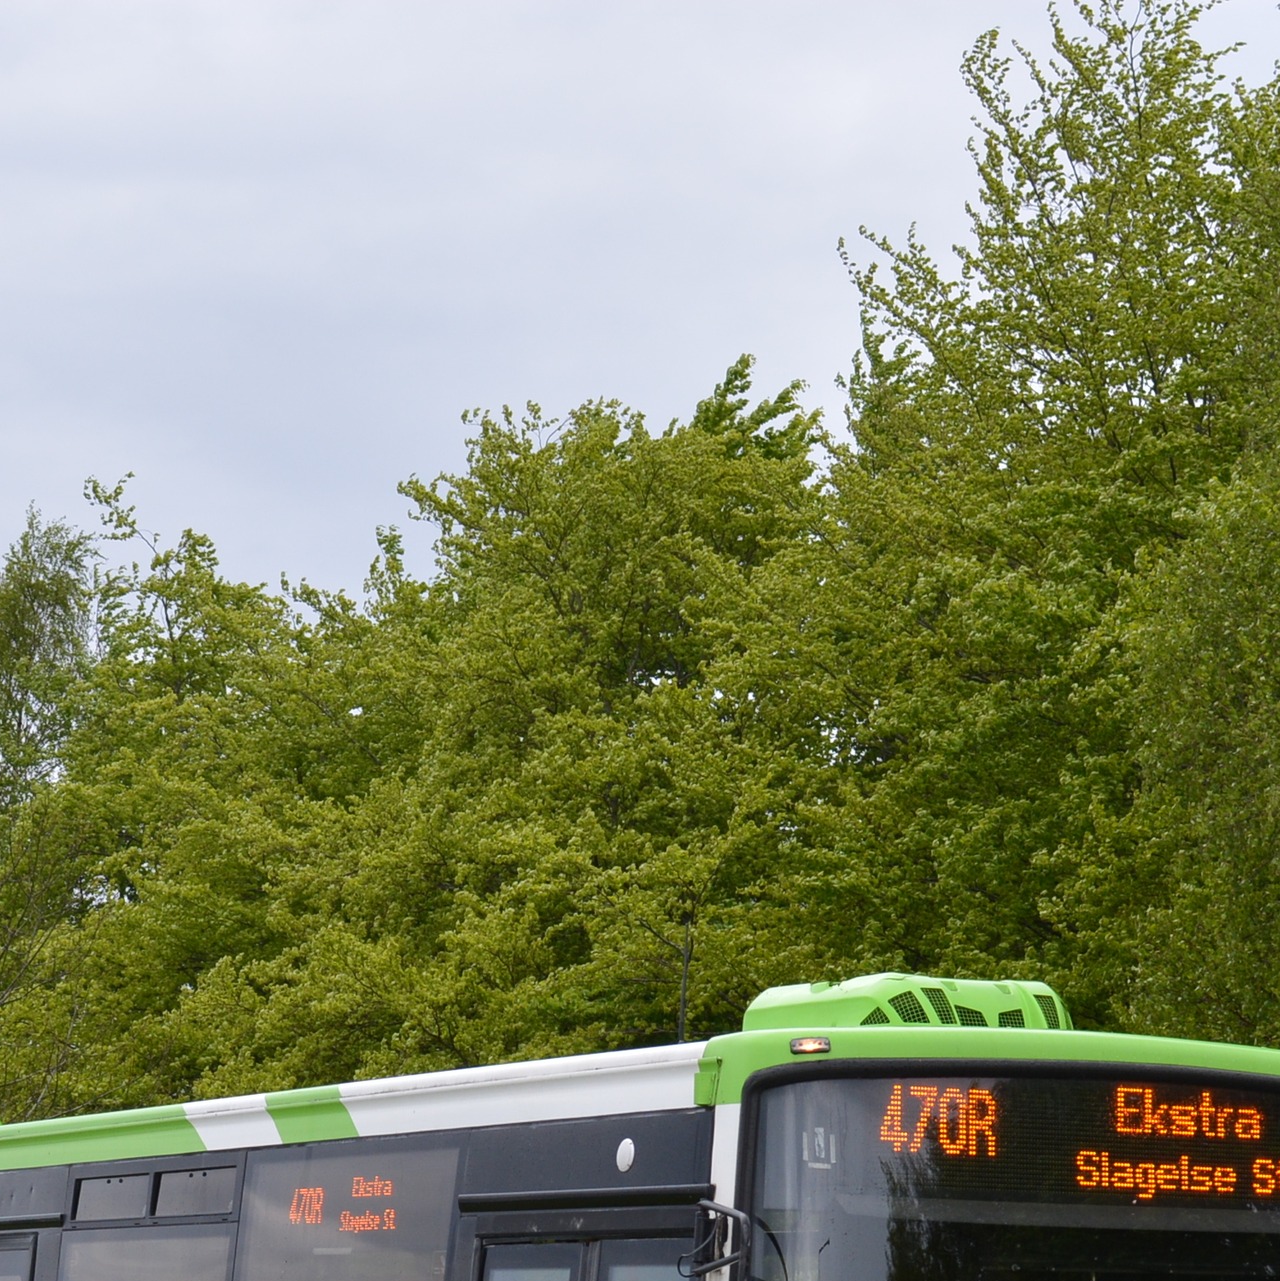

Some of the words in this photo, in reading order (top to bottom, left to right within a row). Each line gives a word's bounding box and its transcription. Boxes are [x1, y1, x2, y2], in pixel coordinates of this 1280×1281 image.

[879, 1084, 997, 1156] 470R
[1115, 1086, 1262, 1140] Ekstra
[351, 1175, 392, 1197] Ekstra
[1076, 1150, 1237, 1199] Slagelse
[289, 1187, 324, 1225] 470R
[339, 1210, 380, 1233] Slagelse
